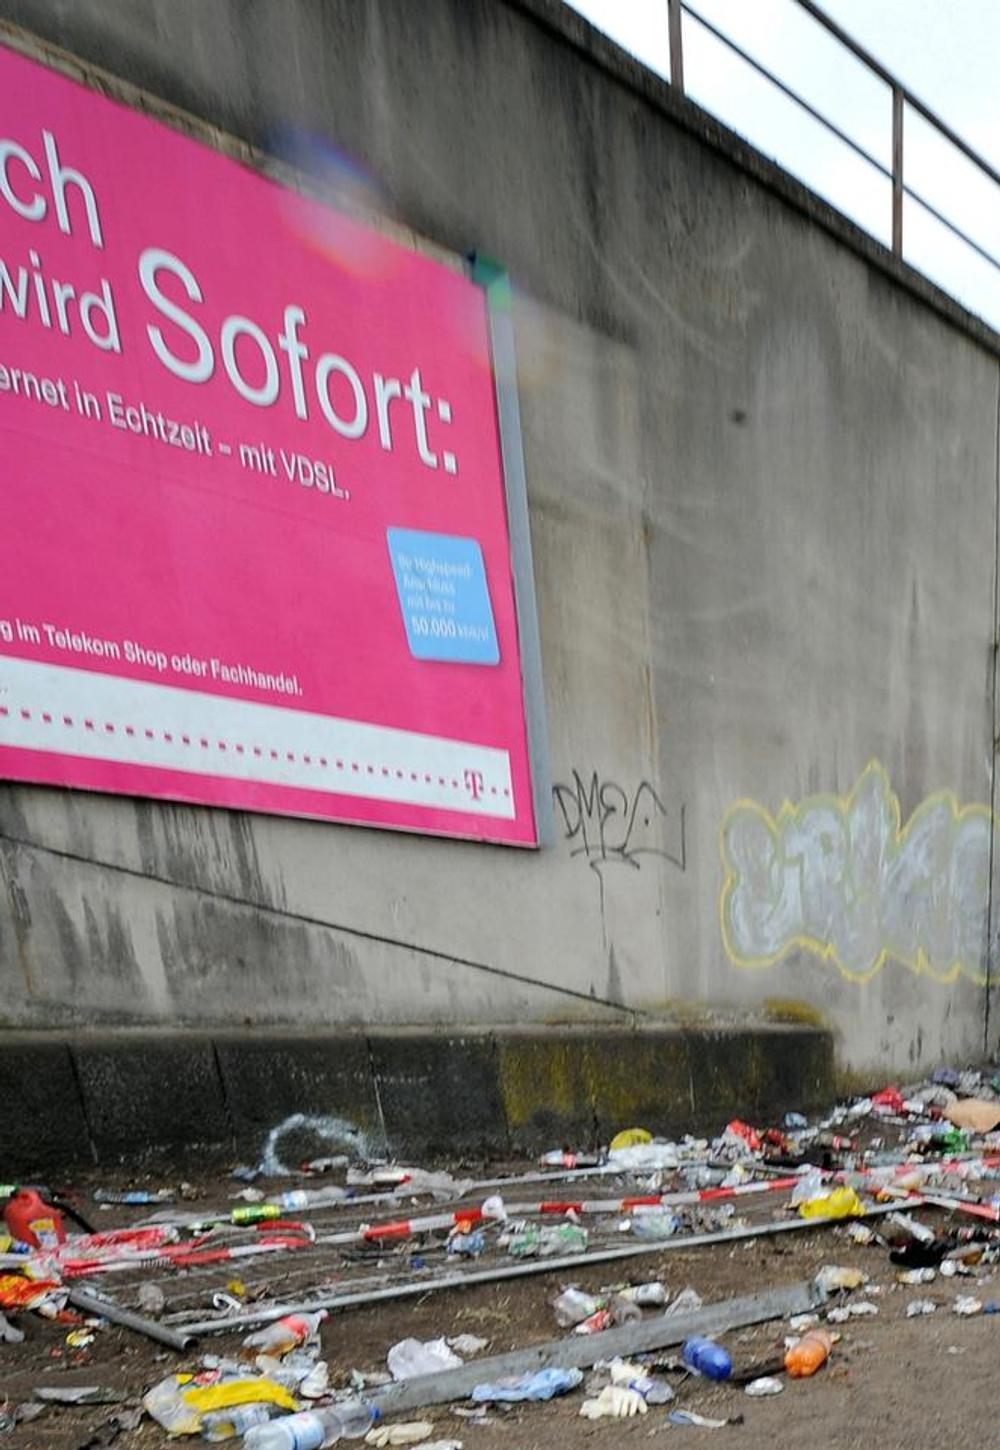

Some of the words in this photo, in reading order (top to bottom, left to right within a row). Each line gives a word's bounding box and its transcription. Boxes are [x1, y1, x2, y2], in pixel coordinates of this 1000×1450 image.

[0, 129, 103, 249] ch
[139, 247, 457, 474] Sofort:
[74, 381, 101, 420] in
[107, 391, 212, 456] Echtzeit
[240, 442, 277, 477] mit
[281, 449, 350, 501] VDSL,
[16, 618, 40, 645] im
[42, 623, 121, 660] Telekom
[123, 640, 167, 671] Shop
[172, 653, 208, 678] oder
[210, 658, 303, 697] Fachhandel.
